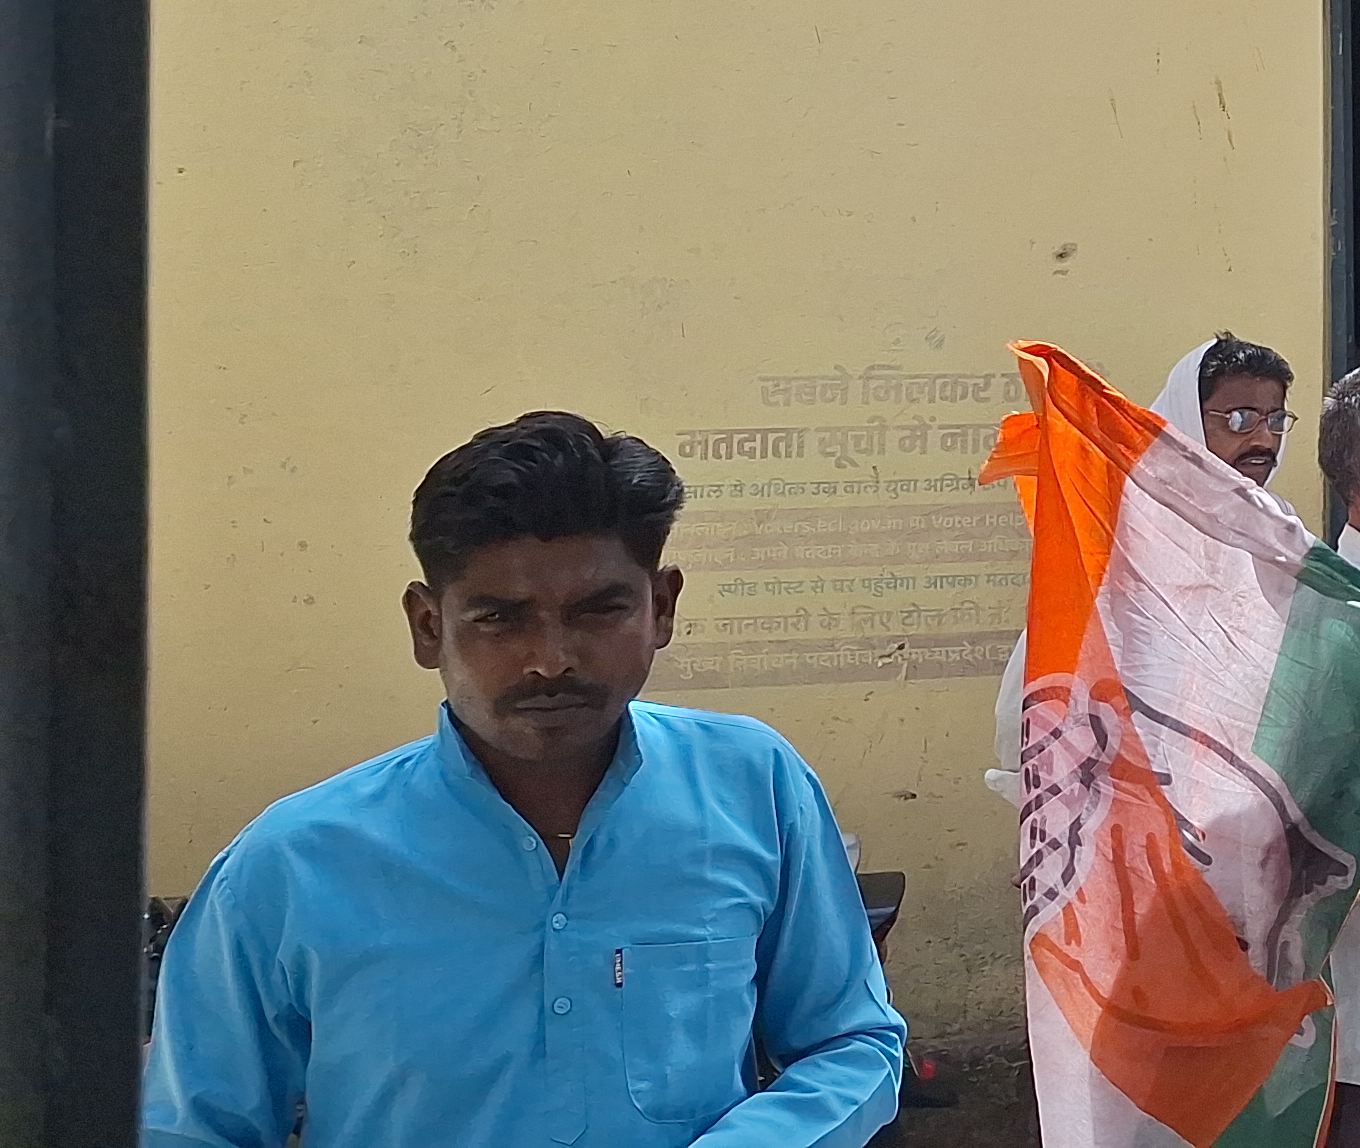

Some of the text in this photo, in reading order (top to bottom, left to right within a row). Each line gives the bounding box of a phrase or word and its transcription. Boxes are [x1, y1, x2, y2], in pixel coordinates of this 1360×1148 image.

[676, 427, 811, 461] मतदाता
[814, 415, 890, 469] सूची
[892, 414, 936, 455] में
[729, 479, 747, 499] से
[749, 478, 807, 498] अधिक
[882, 479, 919, 499] युवा
[717, 577, 758, 597] स्पीड
[763, 576, 805, 596] पोस्ट
[810, 575, 827, 596] से
[831, 578, 857, 595] घर
[924, 573, 979, 590] आपका
[714, 606, 812, 636] जानकारी
[817, 606, 843, 631] के
